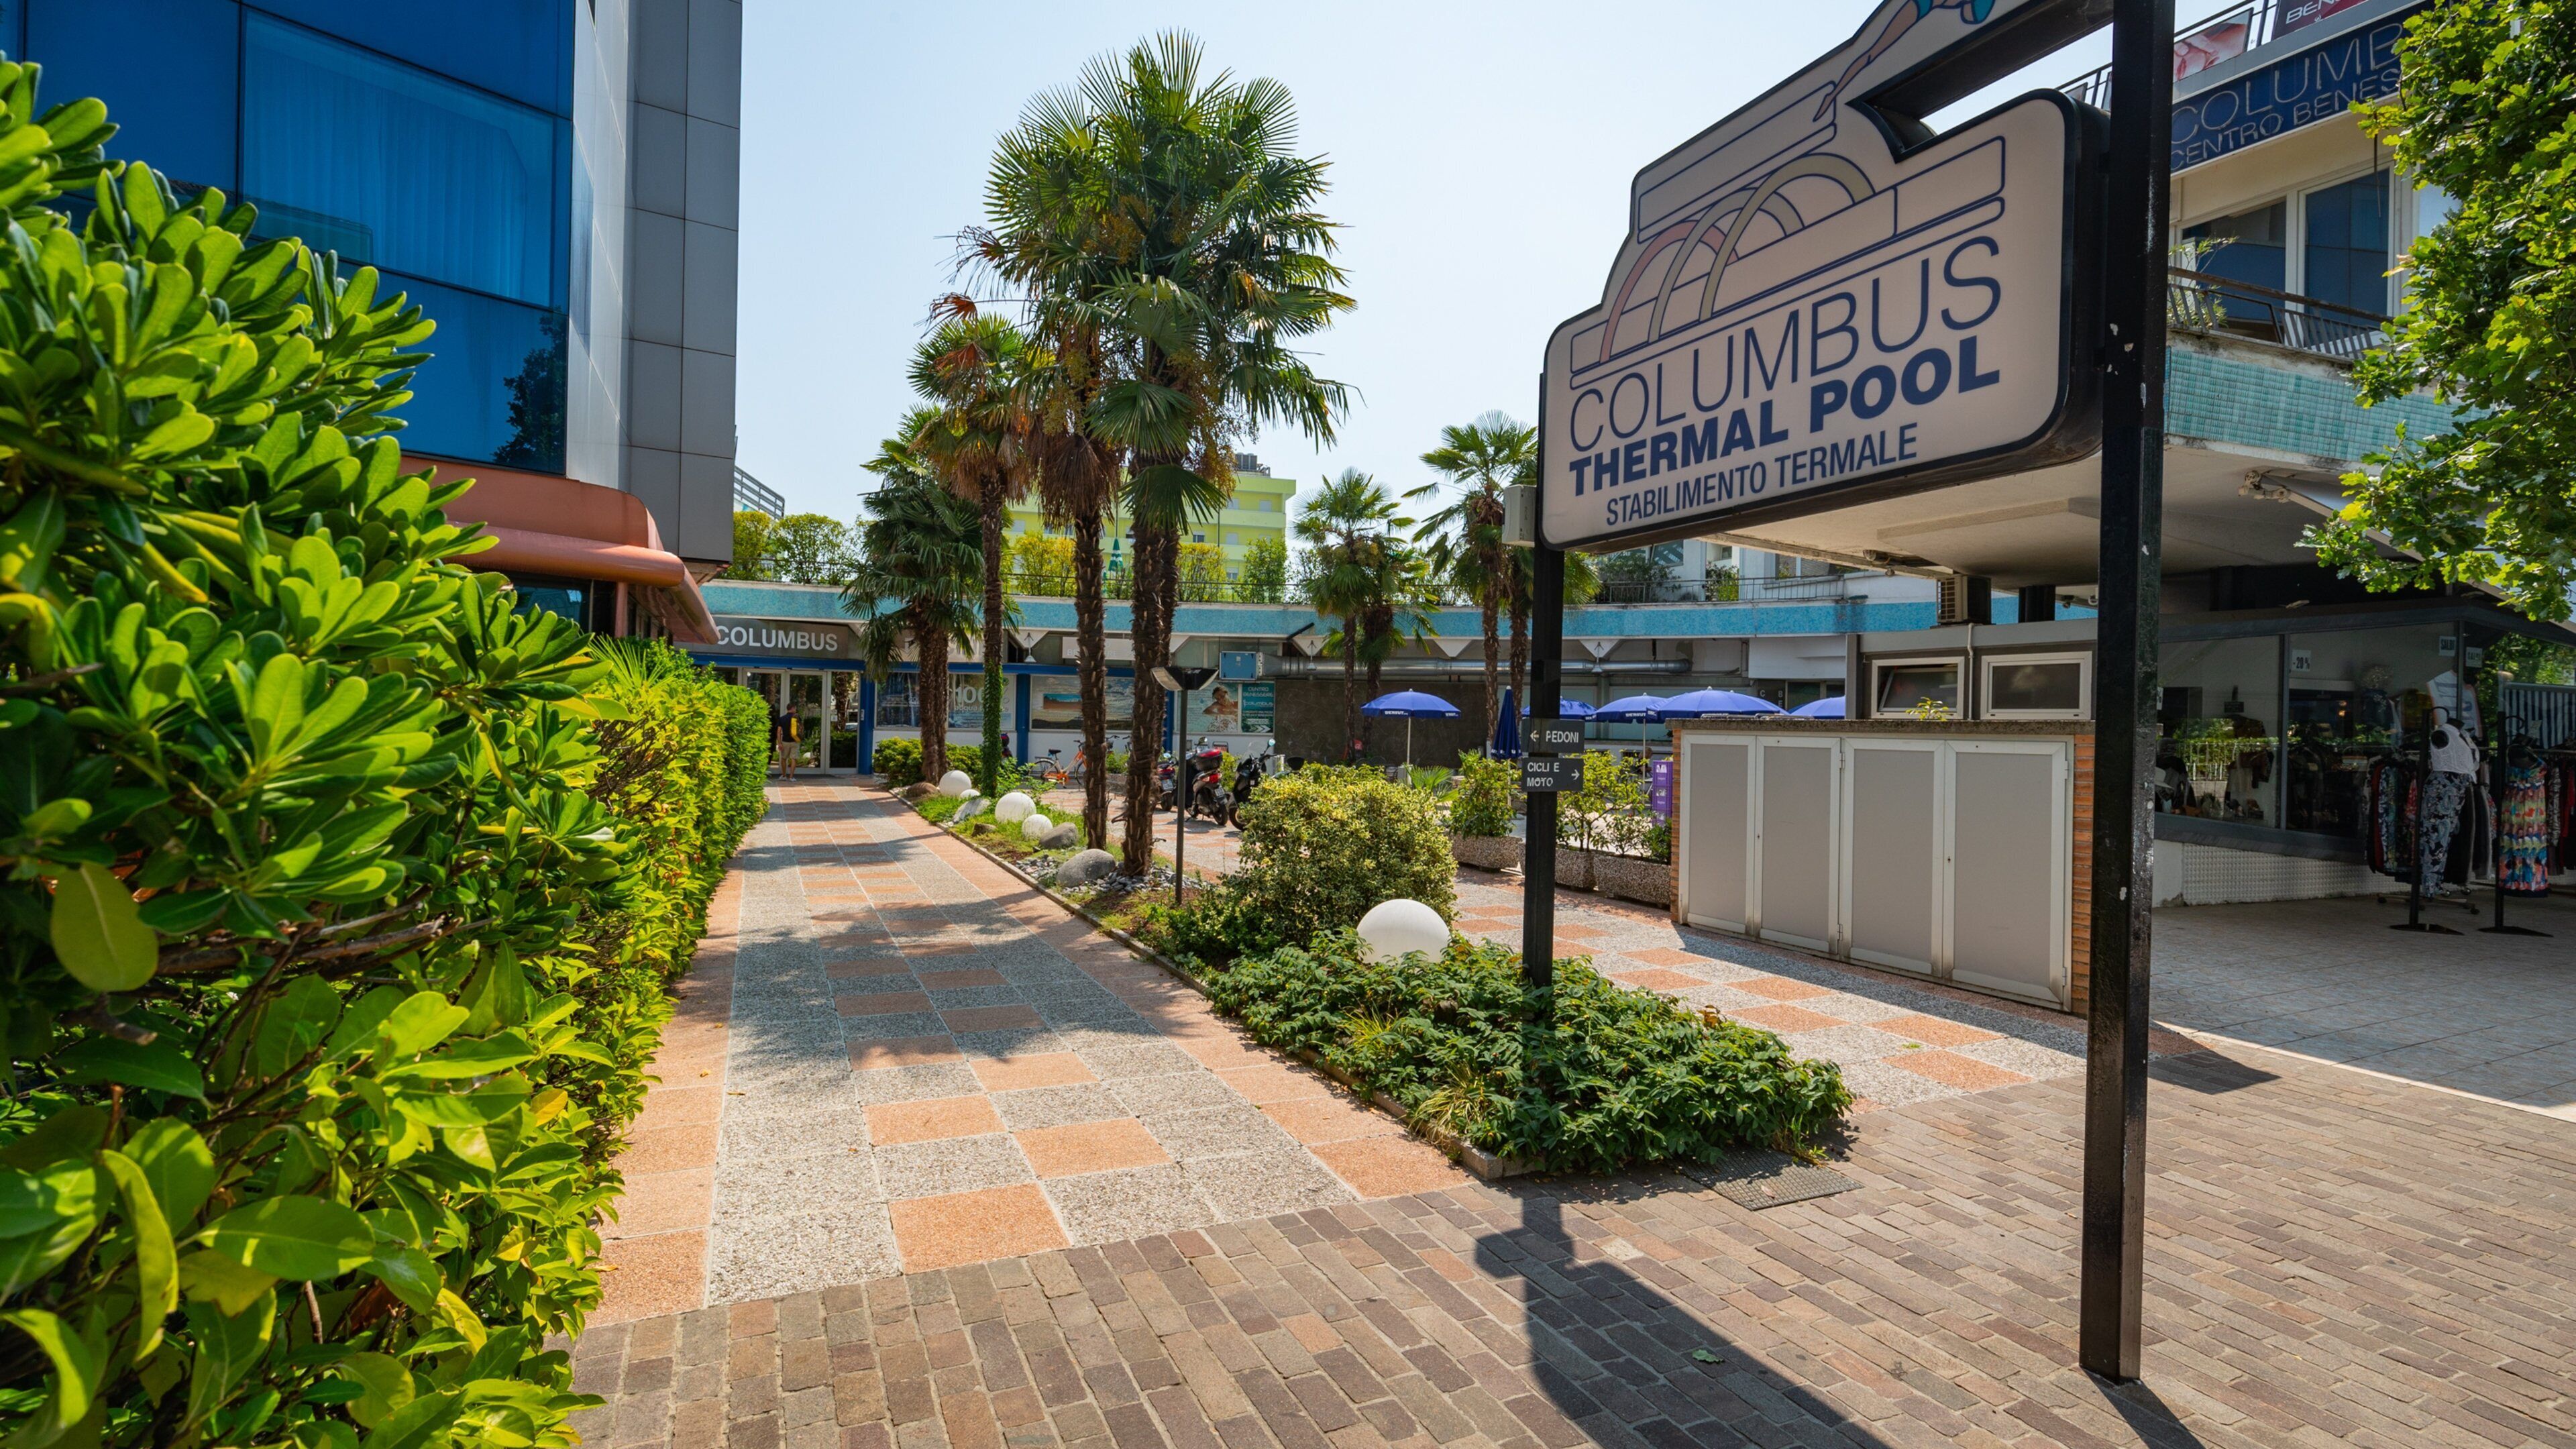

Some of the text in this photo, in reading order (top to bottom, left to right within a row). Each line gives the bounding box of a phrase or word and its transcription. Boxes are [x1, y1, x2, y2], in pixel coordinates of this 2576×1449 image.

[2171, 22, 2404, 144] COLUMB
[2171, 68, 2402, 170] CENTRO BENES
[1570, 235, 2002, 452] COLUMBUS
[1569, 335, 2000, 496] THERMAL POOL
[1605, 422, 1918, 527] STABILIMENTO TERMALE
[717, 625, 838, 651] COLUMBUS
[1526, 777, 1554, 787] MOTO
[1527, 762, 1560, 772] CICLI E
[1545, 731, 1579, 743] PEDONI
